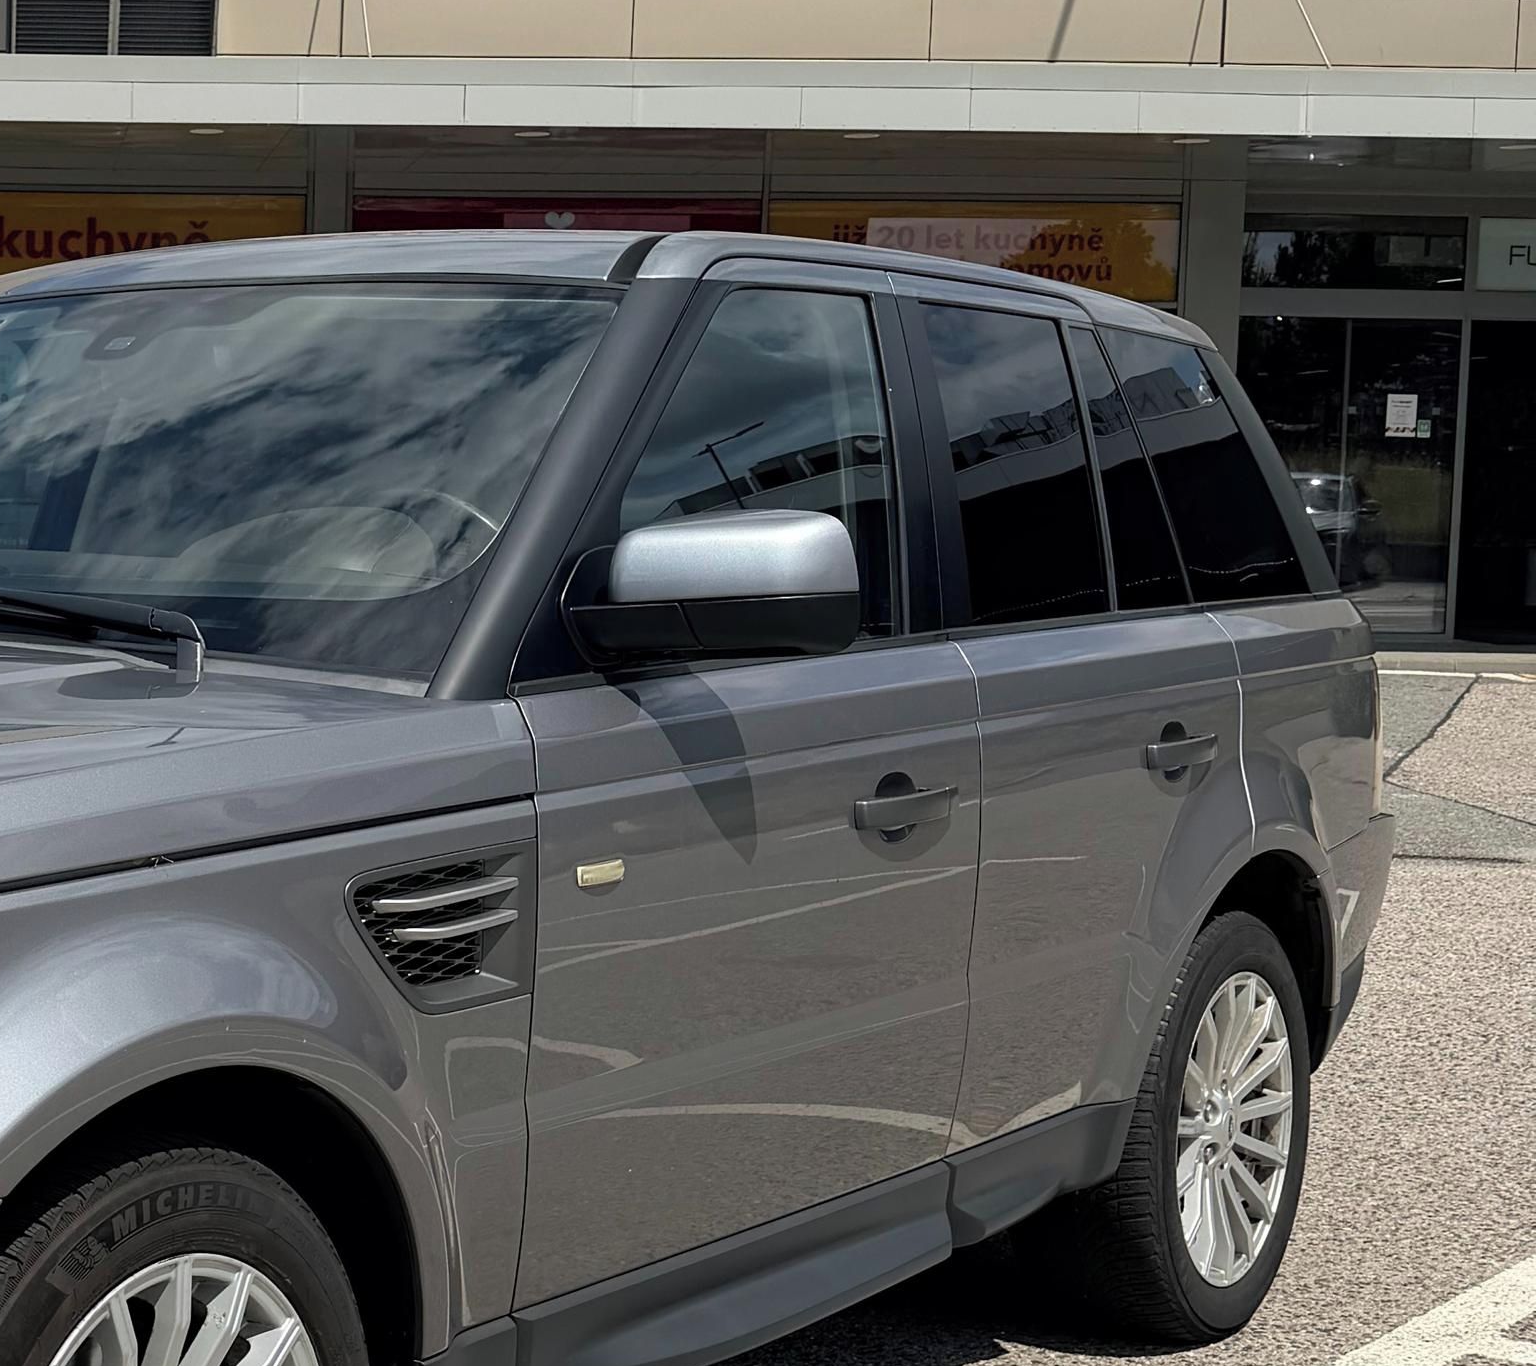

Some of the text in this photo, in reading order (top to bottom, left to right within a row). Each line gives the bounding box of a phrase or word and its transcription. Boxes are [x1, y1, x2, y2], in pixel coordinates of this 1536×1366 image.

[876, 226, 914, 250] 20
[925, 226, 965, 250] let
[973, 225, 1104, 257] kuchyně
